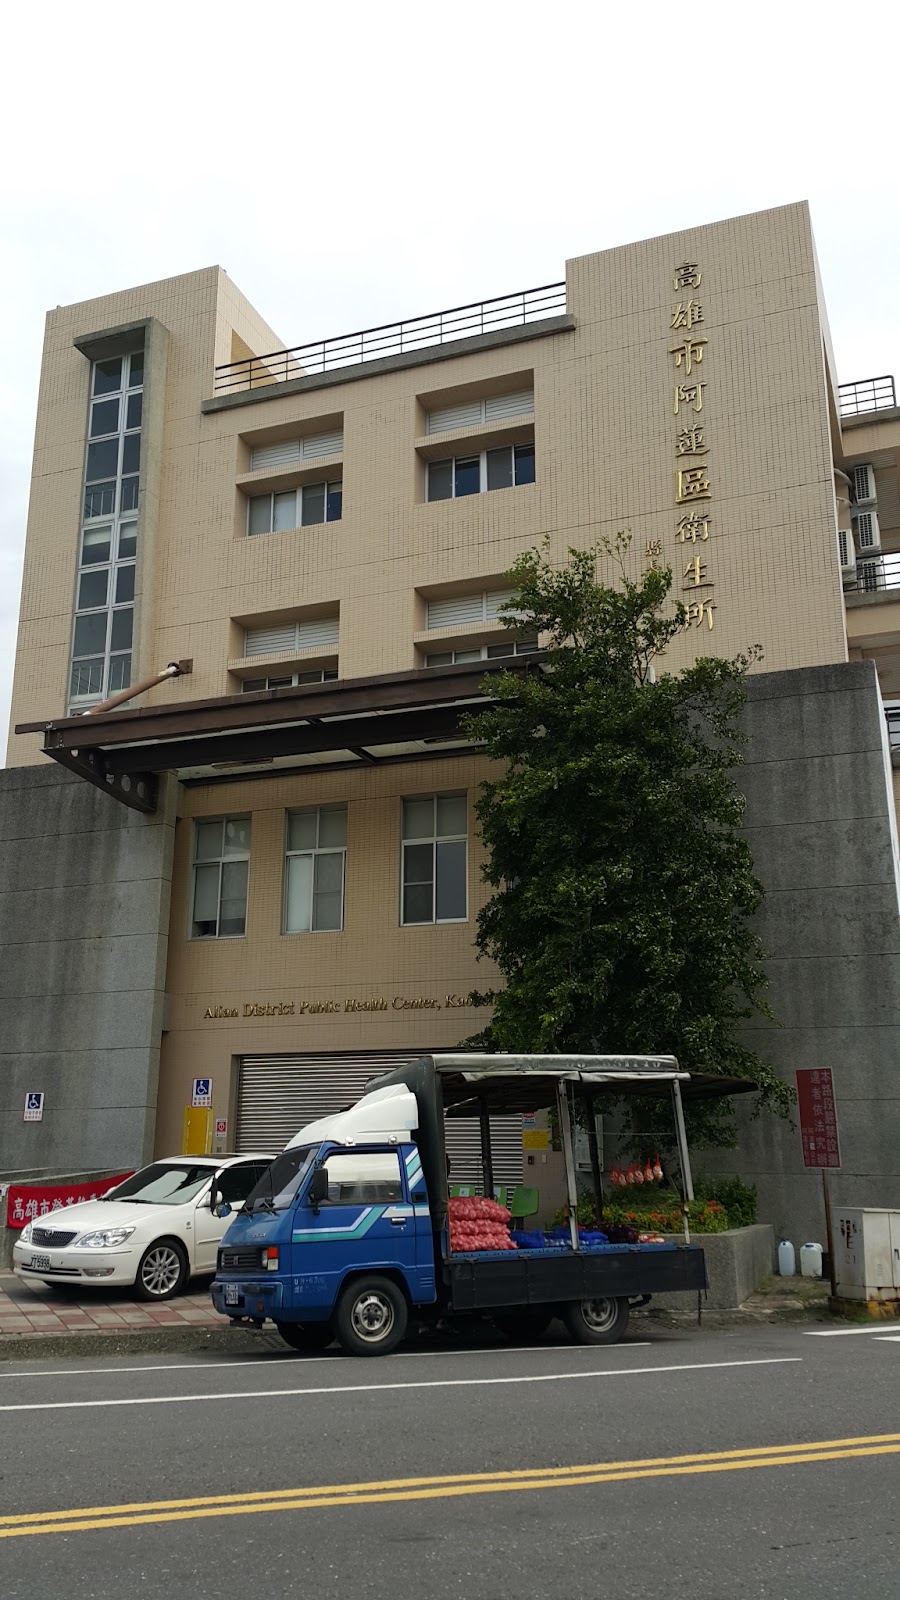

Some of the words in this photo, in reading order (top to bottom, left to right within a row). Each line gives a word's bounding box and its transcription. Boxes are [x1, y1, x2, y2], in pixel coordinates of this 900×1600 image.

[669, 260, 718, 632] 高雄市阿蓮區衛生所
[203, 1006, 239, 1019] Alian
[242, 1001, 295, 1018] District
[299, 1000, 341, 1015] Public
[344, 998, 388, 1013] Health
[391, 996, 442, 1012] Center,
